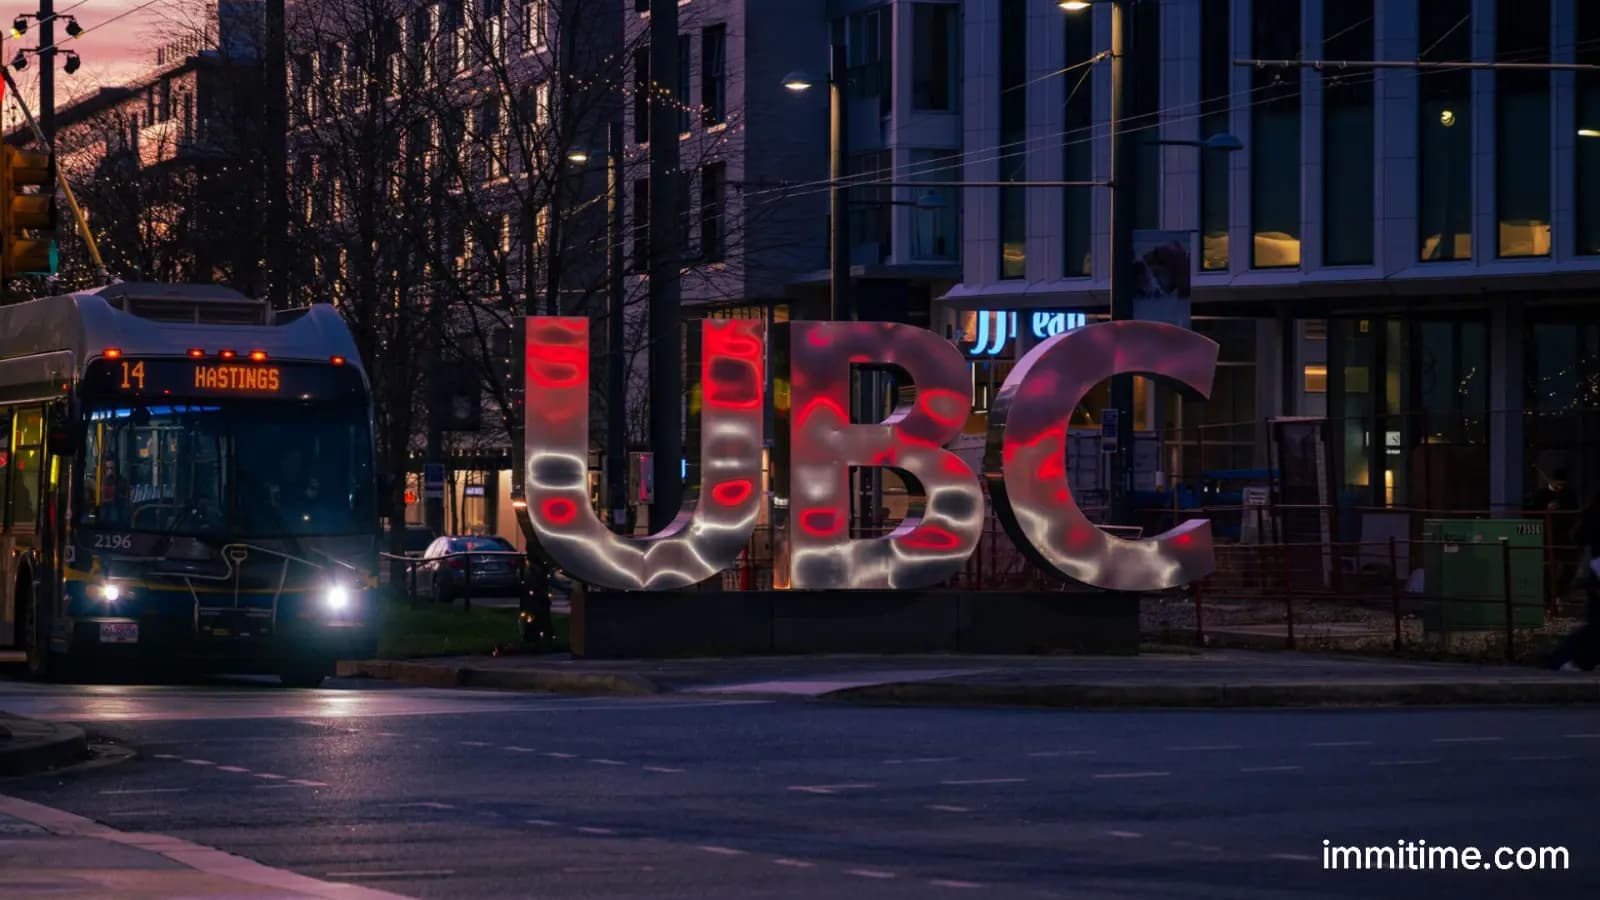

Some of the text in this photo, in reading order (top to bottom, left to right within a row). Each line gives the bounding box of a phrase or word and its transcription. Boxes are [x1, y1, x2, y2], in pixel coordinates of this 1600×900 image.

[1008, 311, 1087, 338] ean
[120, 360, 280, 390] 14 HASTINGS
[513, 316, 1219, 591] UBC
[94, 534, 132, 549] 2196
